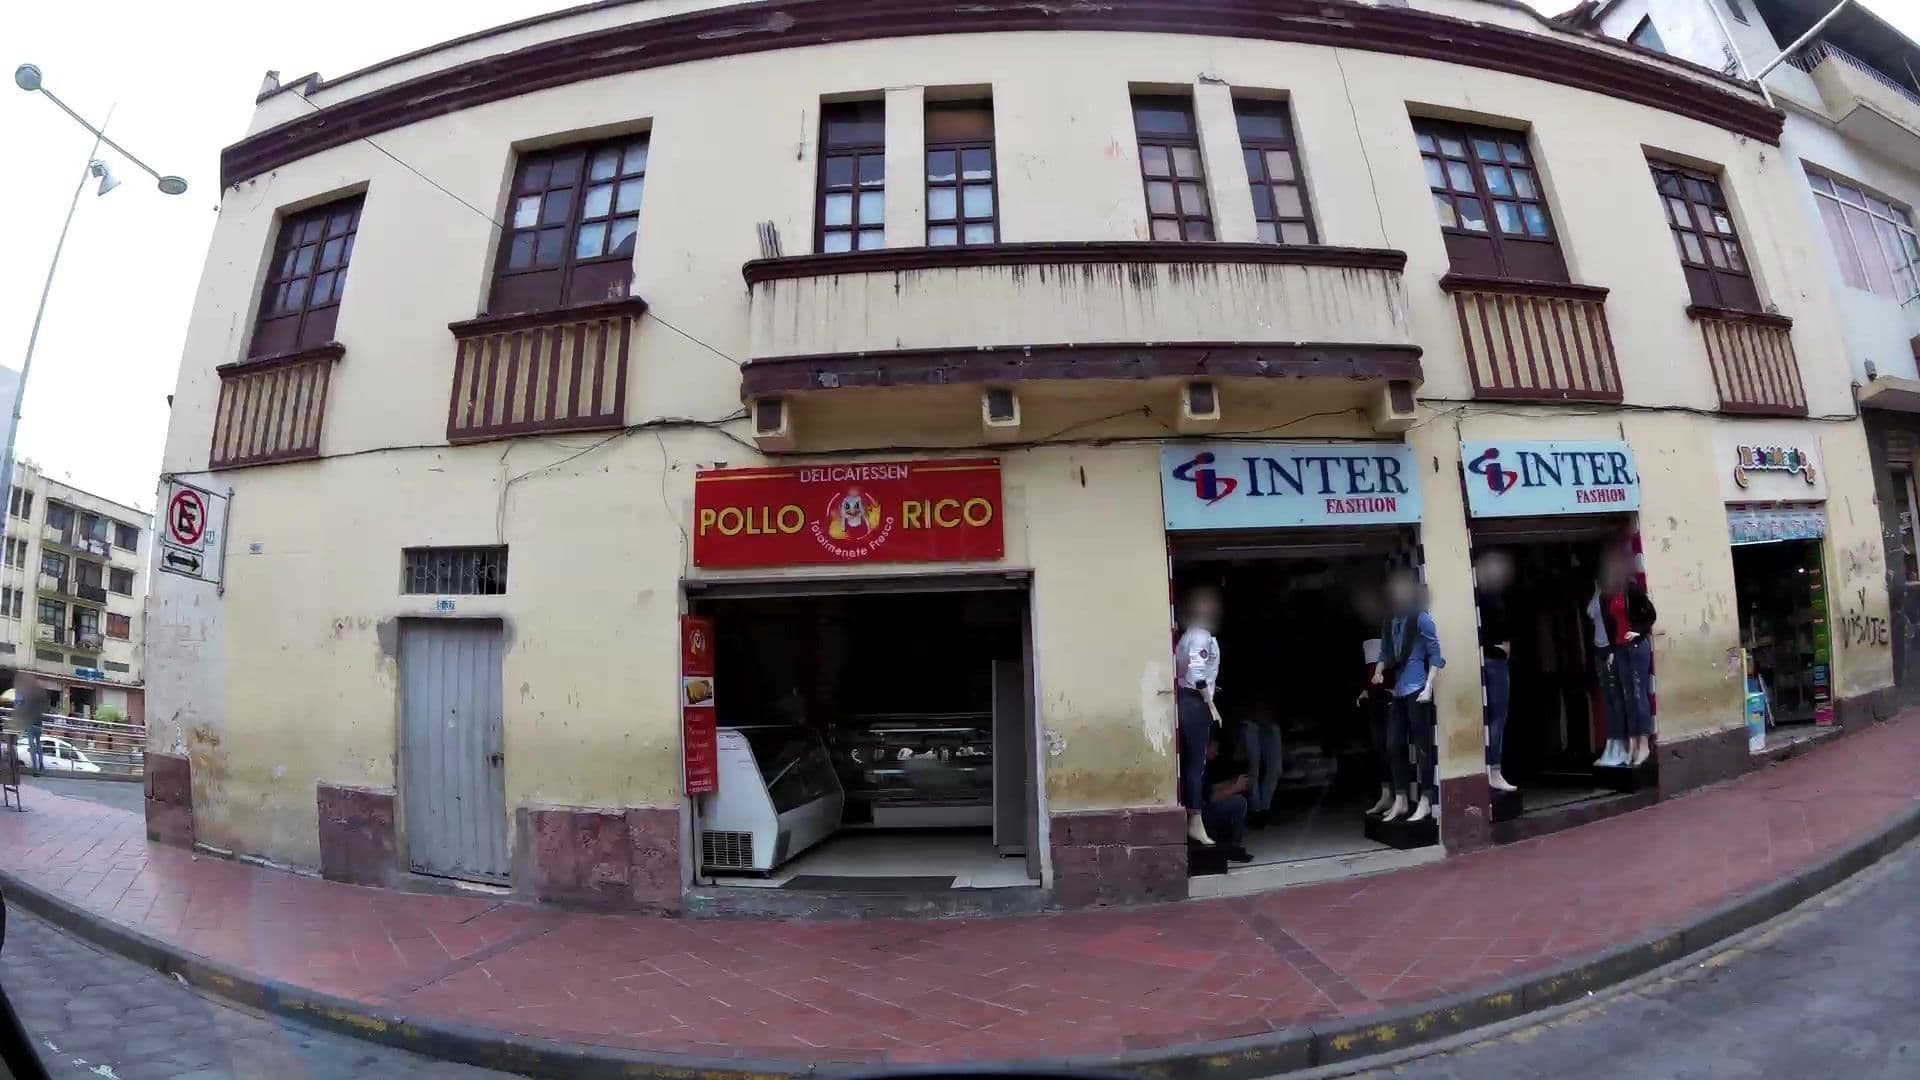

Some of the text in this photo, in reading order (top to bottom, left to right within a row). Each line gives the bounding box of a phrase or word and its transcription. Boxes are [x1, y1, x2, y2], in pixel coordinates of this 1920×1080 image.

[800, 464, 908, 483] DELICATESSEN
[1242, 455, 1409, 498] INTER
[1514, 450, 1635, 488] INTER
[1326, 496, 1397, 515] FASHION
[1575, 487, 1627, 504] FASHION
[699, 497, 993, 537] POLLO RICO
